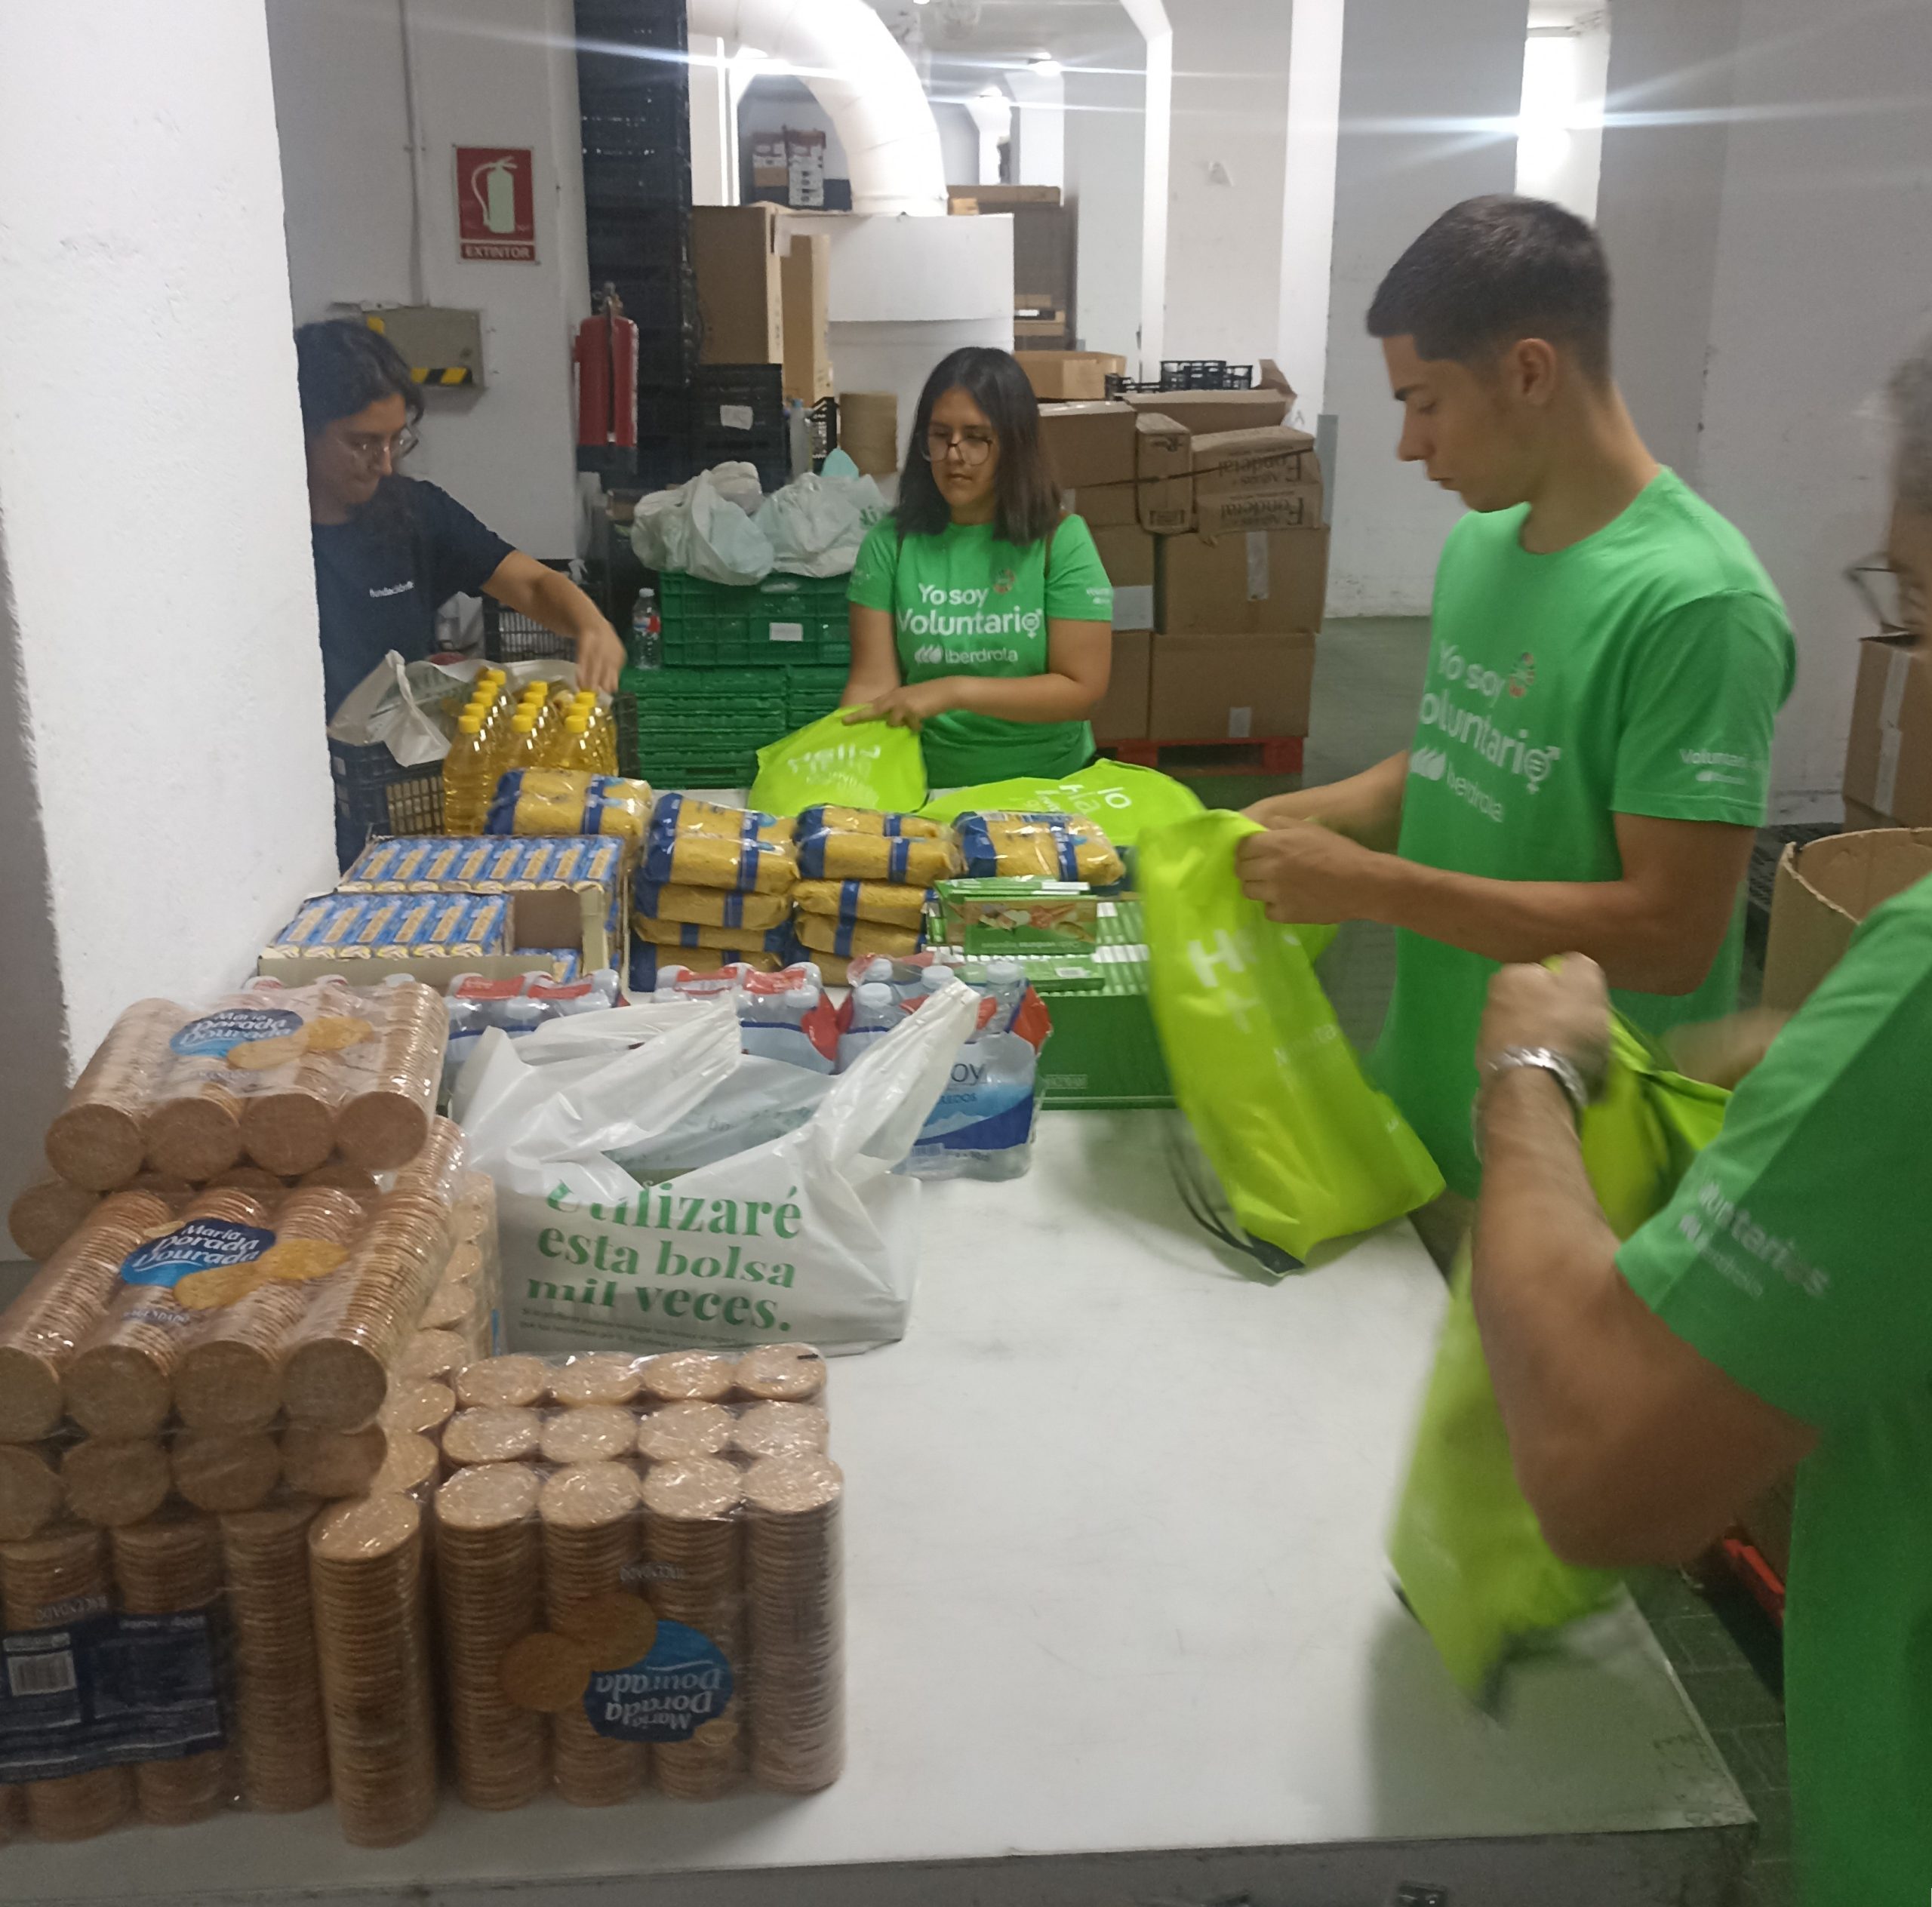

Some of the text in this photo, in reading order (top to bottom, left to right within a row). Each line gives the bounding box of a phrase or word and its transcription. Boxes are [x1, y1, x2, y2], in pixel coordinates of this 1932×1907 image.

[464, 245, 531, 259] EXTINTOR
[918, 583, 989, 607] Yo soy
[1438, 641, 1506, 708] Yo soy
[131, 1247, 260, 1269] Dourada
[151, 1235, 260, 1256] Dorada
[537, 1227, 796, 1288] esta bolsa
[528, 1278, 619, 1307] mil
[635, 1286, 791, 1333] veces.
[595, 1668, 721, 1699] Dourada
[604, 1690, 713, 1725] Dorada
